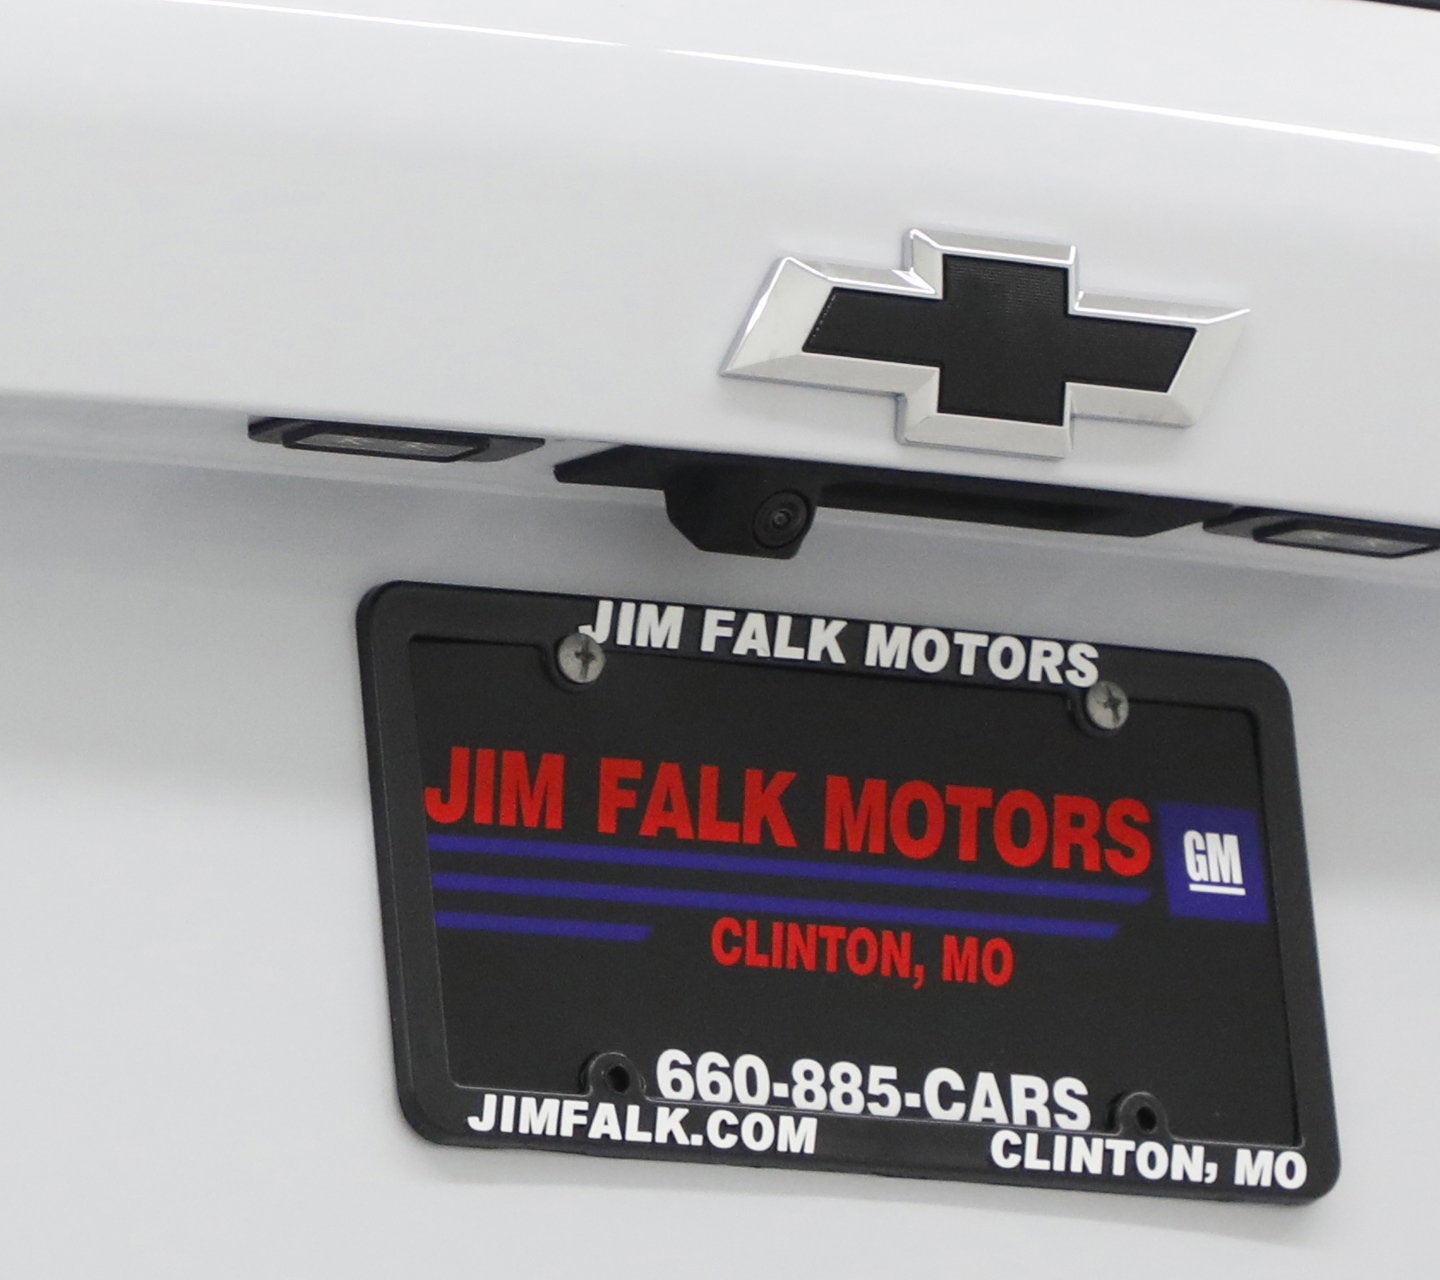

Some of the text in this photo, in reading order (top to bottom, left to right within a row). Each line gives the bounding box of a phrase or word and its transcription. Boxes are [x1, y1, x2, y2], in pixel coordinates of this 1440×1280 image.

[579, 600, 1099, 689] JIM FALK MOTORS
[425, 747, 1151, 875] JIM FALK MOTORS
[1184, 829, 1243, 887] GM
[711, 918, 1013, 990] CLINTON, MO
[468, 1094, 817, 1154] JIMFALK.COM
[655, 1048, 1091, 1130] 660-885-CARS
[992, 1130, 1306, 1190] CLINTON, MO
